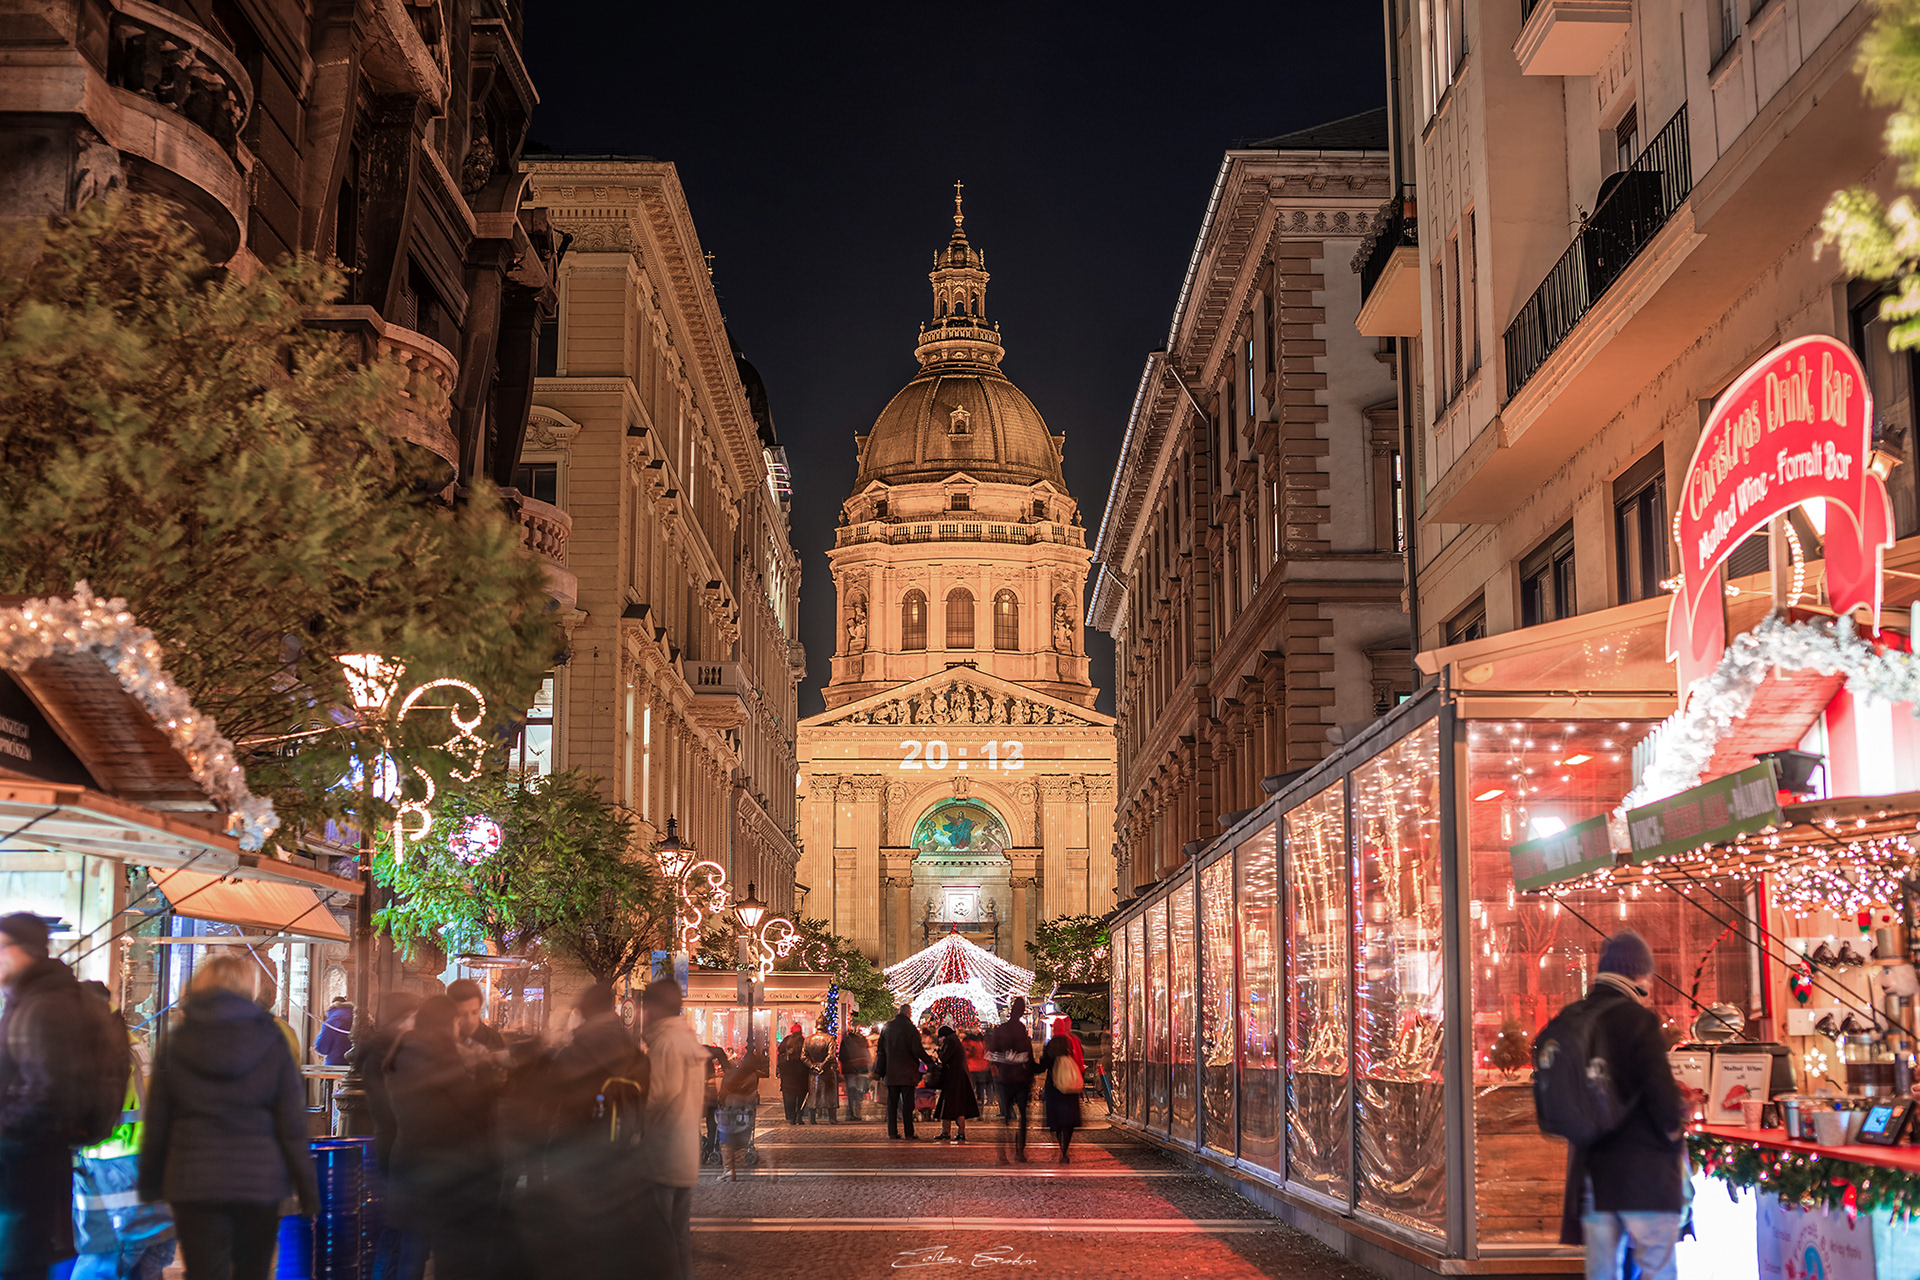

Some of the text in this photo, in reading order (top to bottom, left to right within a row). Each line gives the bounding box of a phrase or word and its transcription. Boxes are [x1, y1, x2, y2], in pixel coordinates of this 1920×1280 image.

[1689, 351, 1853, 522] Christmas Drink Bar
[1698, 492, 1737, 570] Mulled
[1737, 471, 1768, 516] Wine
[1777, 441, 1823, 485] Forralt
[1824, 440, 1852, 481] Bor
